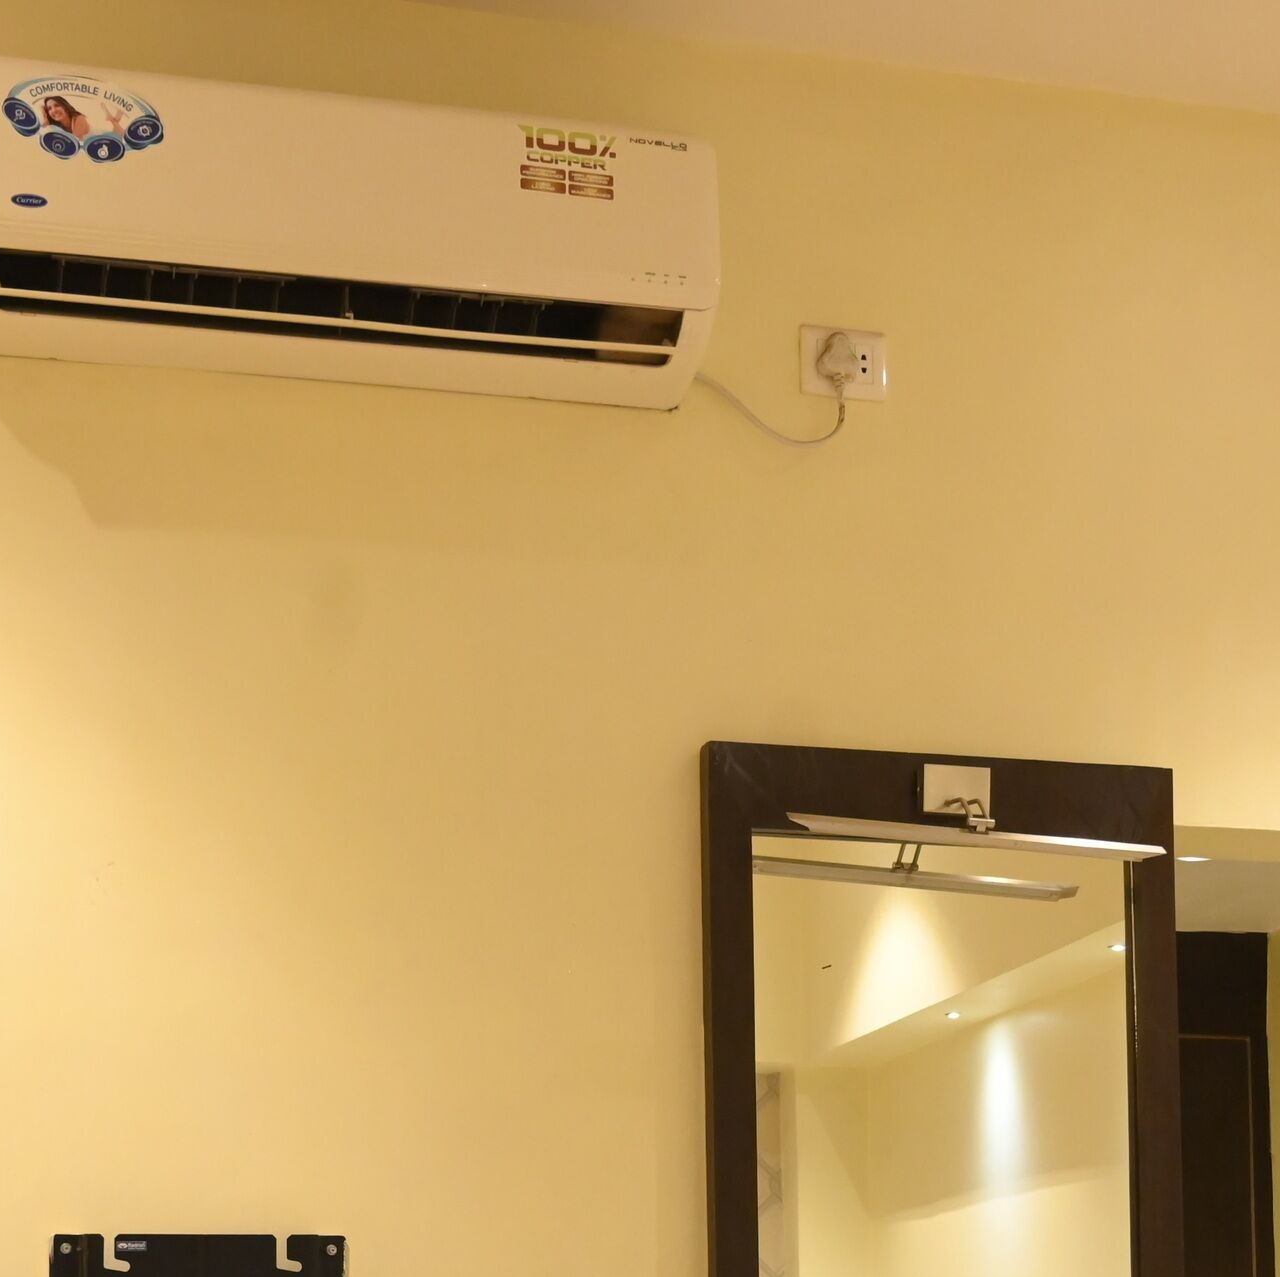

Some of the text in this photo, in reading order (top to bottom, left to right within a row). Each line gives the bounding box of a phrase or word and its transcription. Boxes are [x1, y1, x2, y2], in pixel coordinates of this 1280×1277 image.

[29, 82, 134, 112] COMFORTABLE LIVING
[517, 124, 617, 159] 100%
[526, 149, 607, 171] COPPER
[16, 195, 43, 205] Carrier
